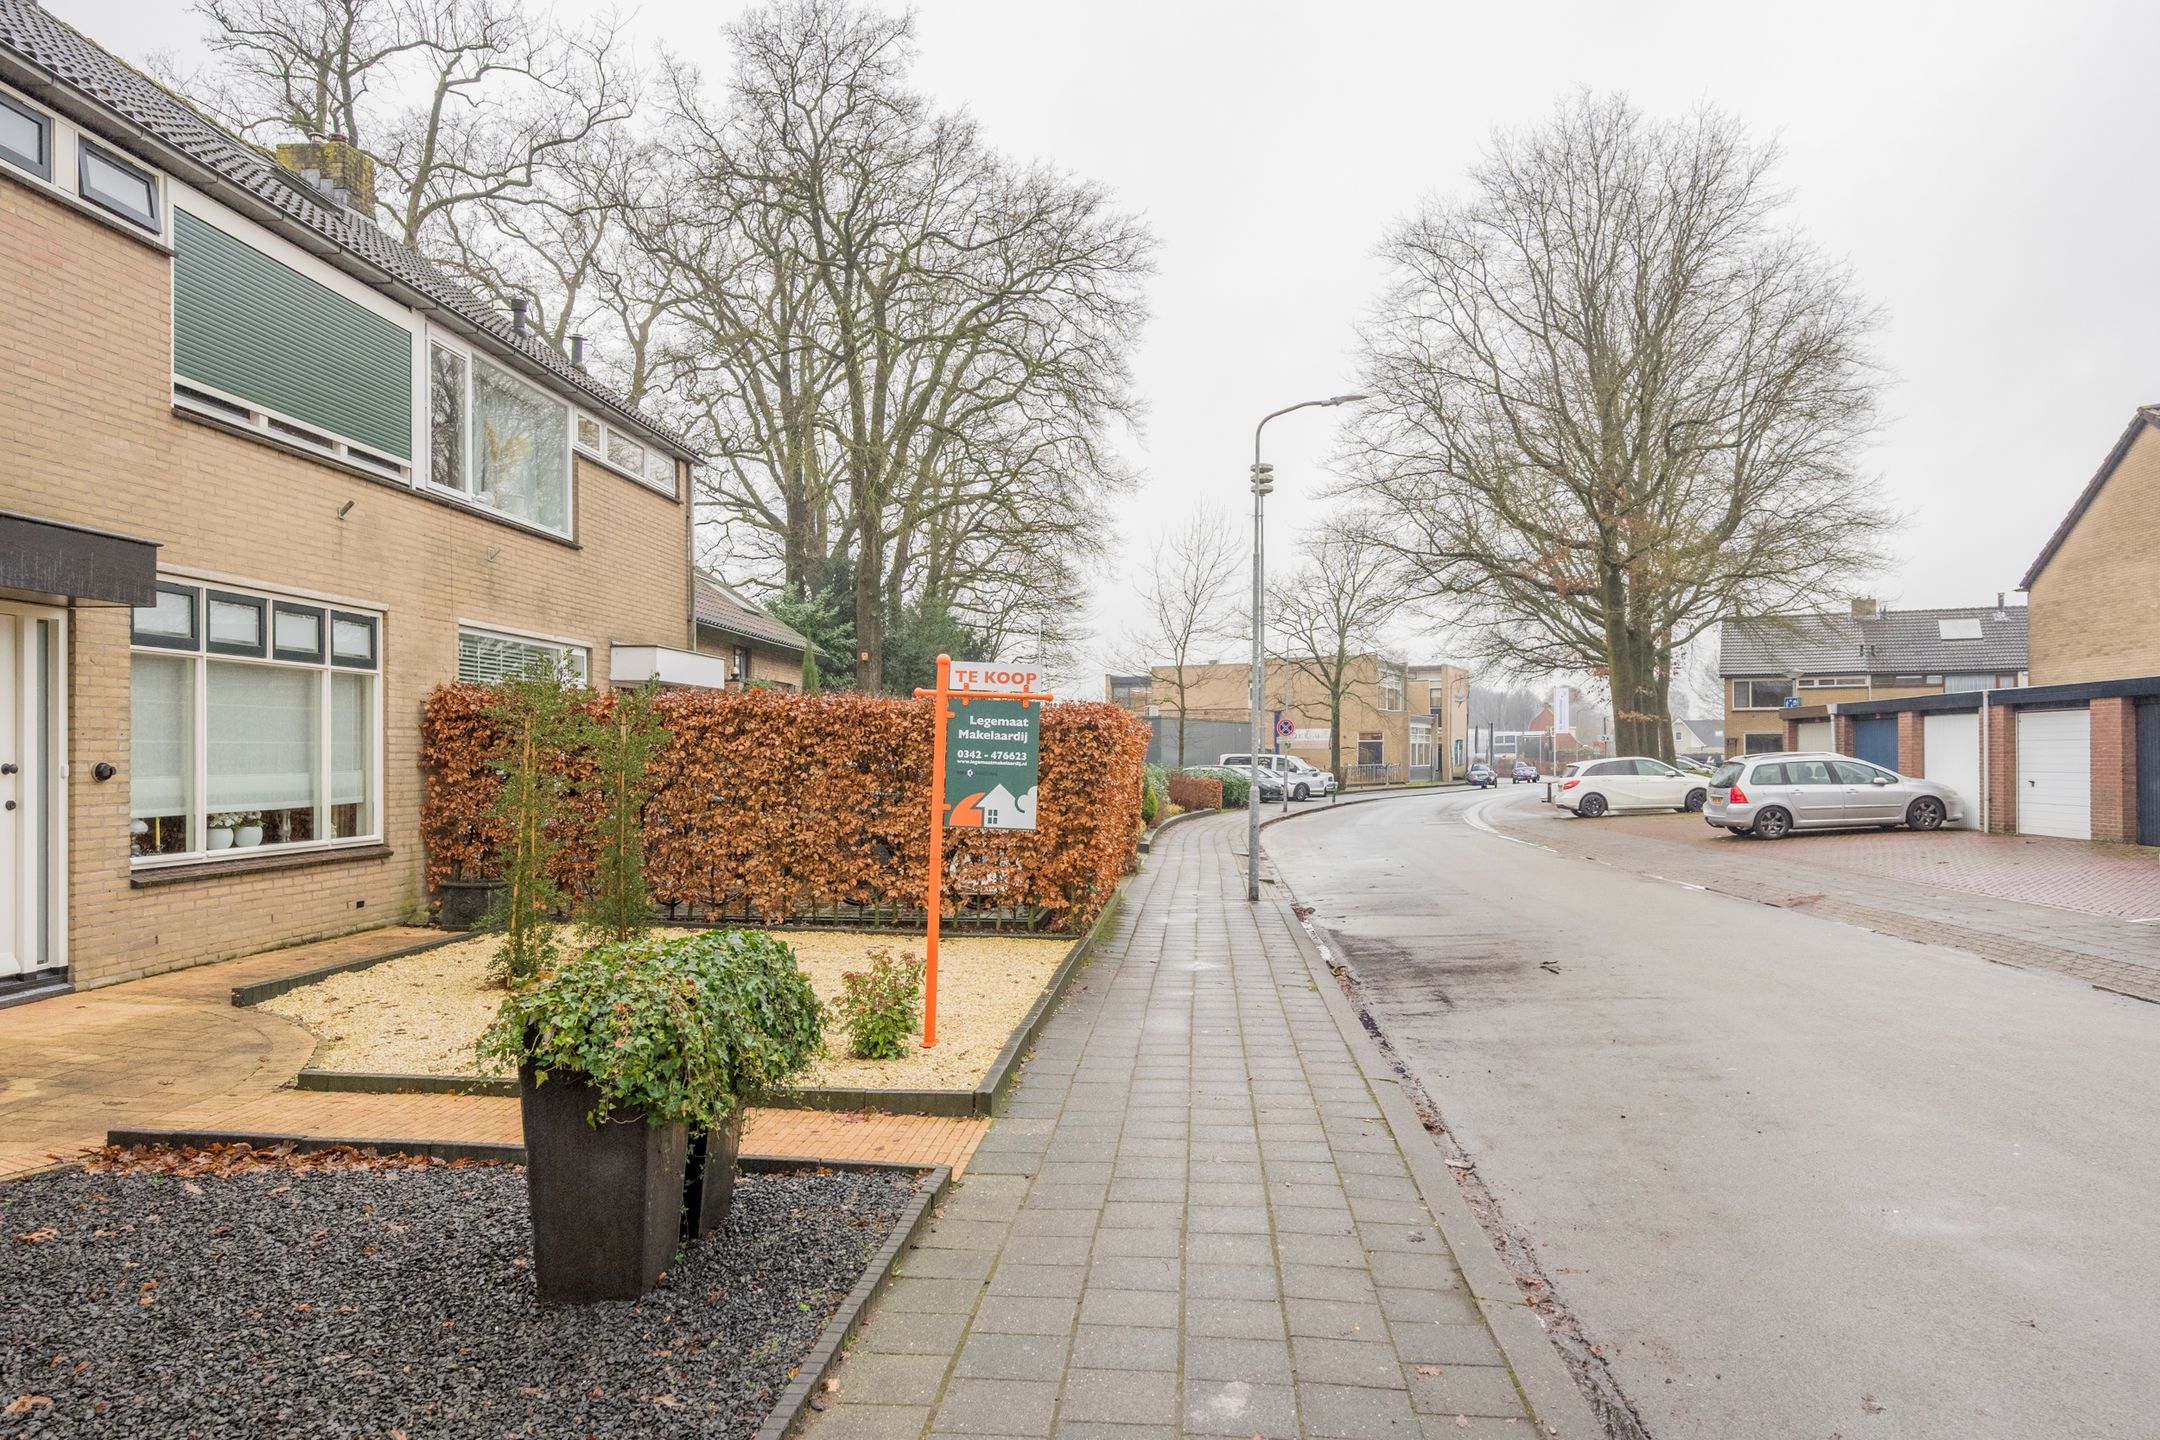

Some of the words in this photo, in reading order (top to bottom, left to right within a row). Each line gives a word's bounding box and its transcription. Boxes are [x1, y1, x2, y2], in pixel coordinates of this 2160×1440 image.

[955, 670, 978, 683] TE
[984, 671, 1037, 686] KOOP
[969, 715, 1029, 728] Legemaat
[958, 730, 1028, 744] Makelaardij
[957, 750, 981, 759] 0342
[991, 751, 1027, 761] 476623
